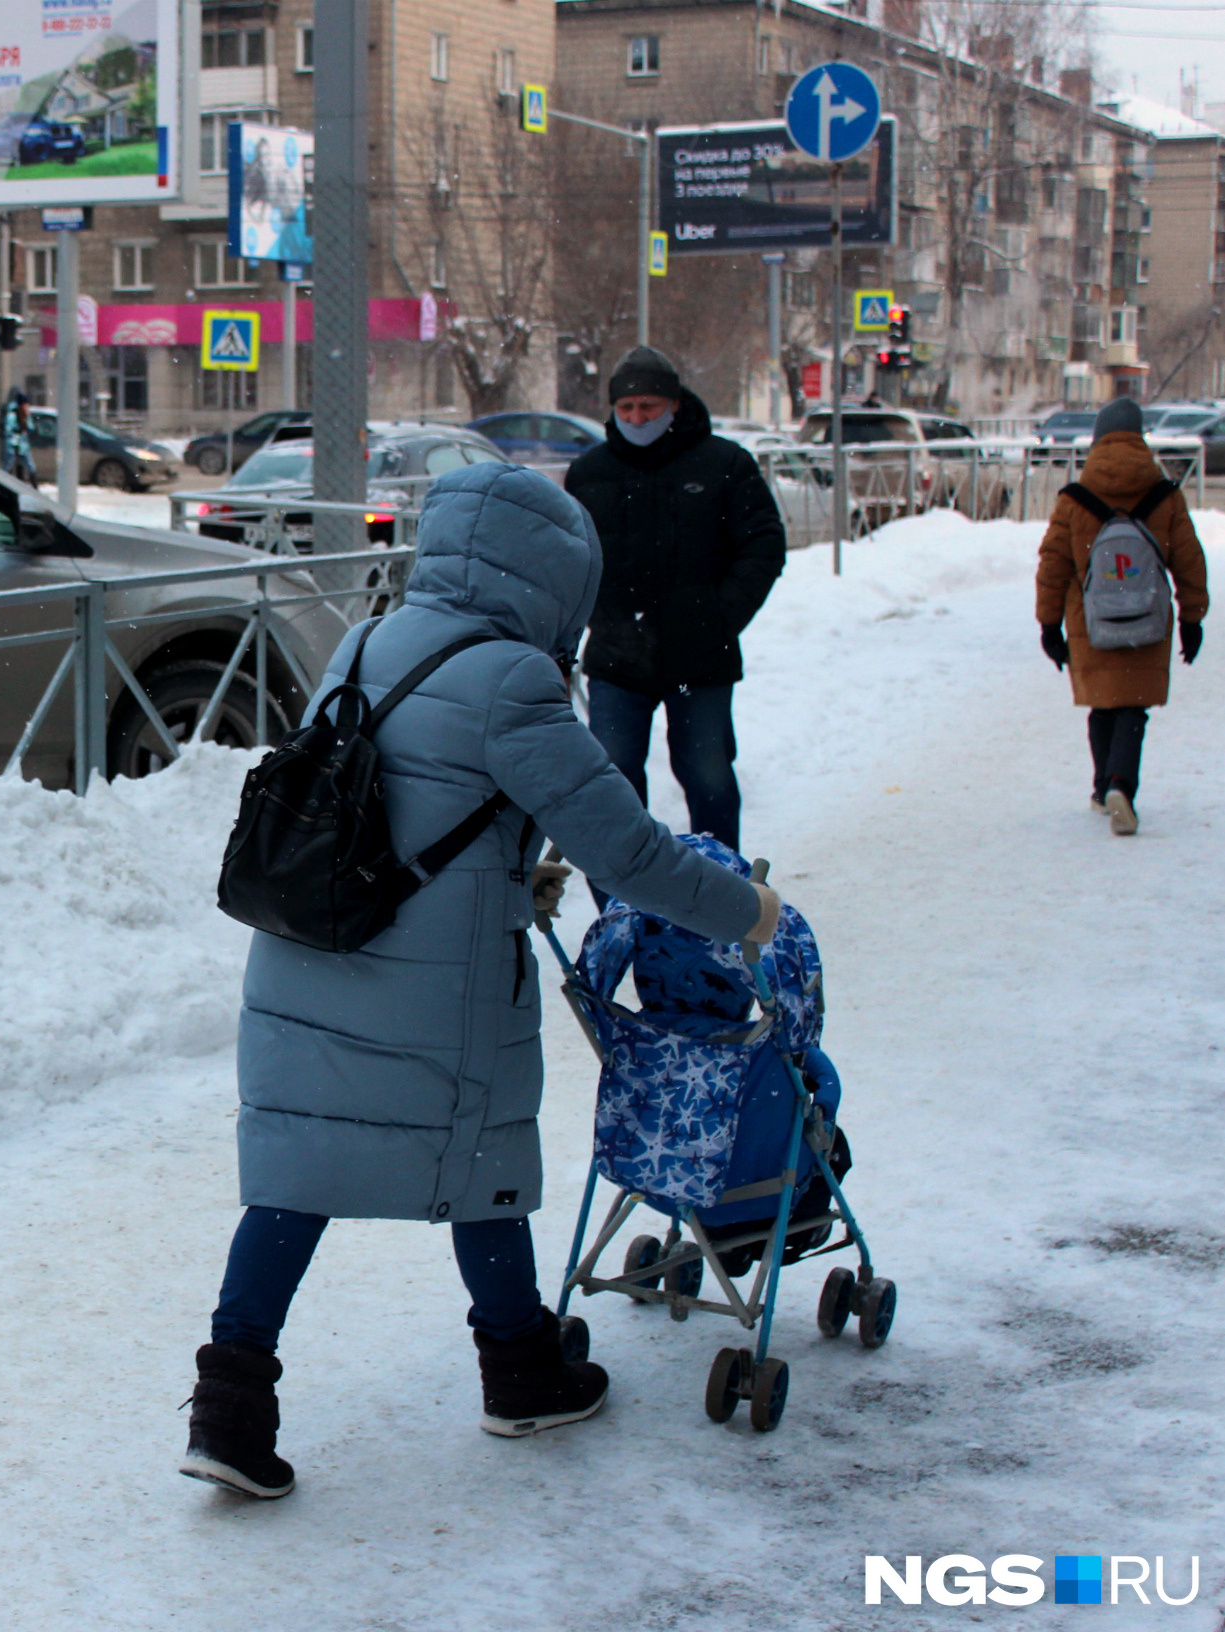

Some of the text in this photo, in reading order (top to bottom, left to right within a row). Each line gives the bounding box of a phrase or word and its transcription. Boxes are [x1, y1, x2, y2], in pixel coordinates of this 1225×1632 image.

[675, 143, 785, 165] Скидка до 30%
[675, 164, 751, 182] на первые
[676, 182, 685, 198] 3
[675, 222, 716, 240] Uber
